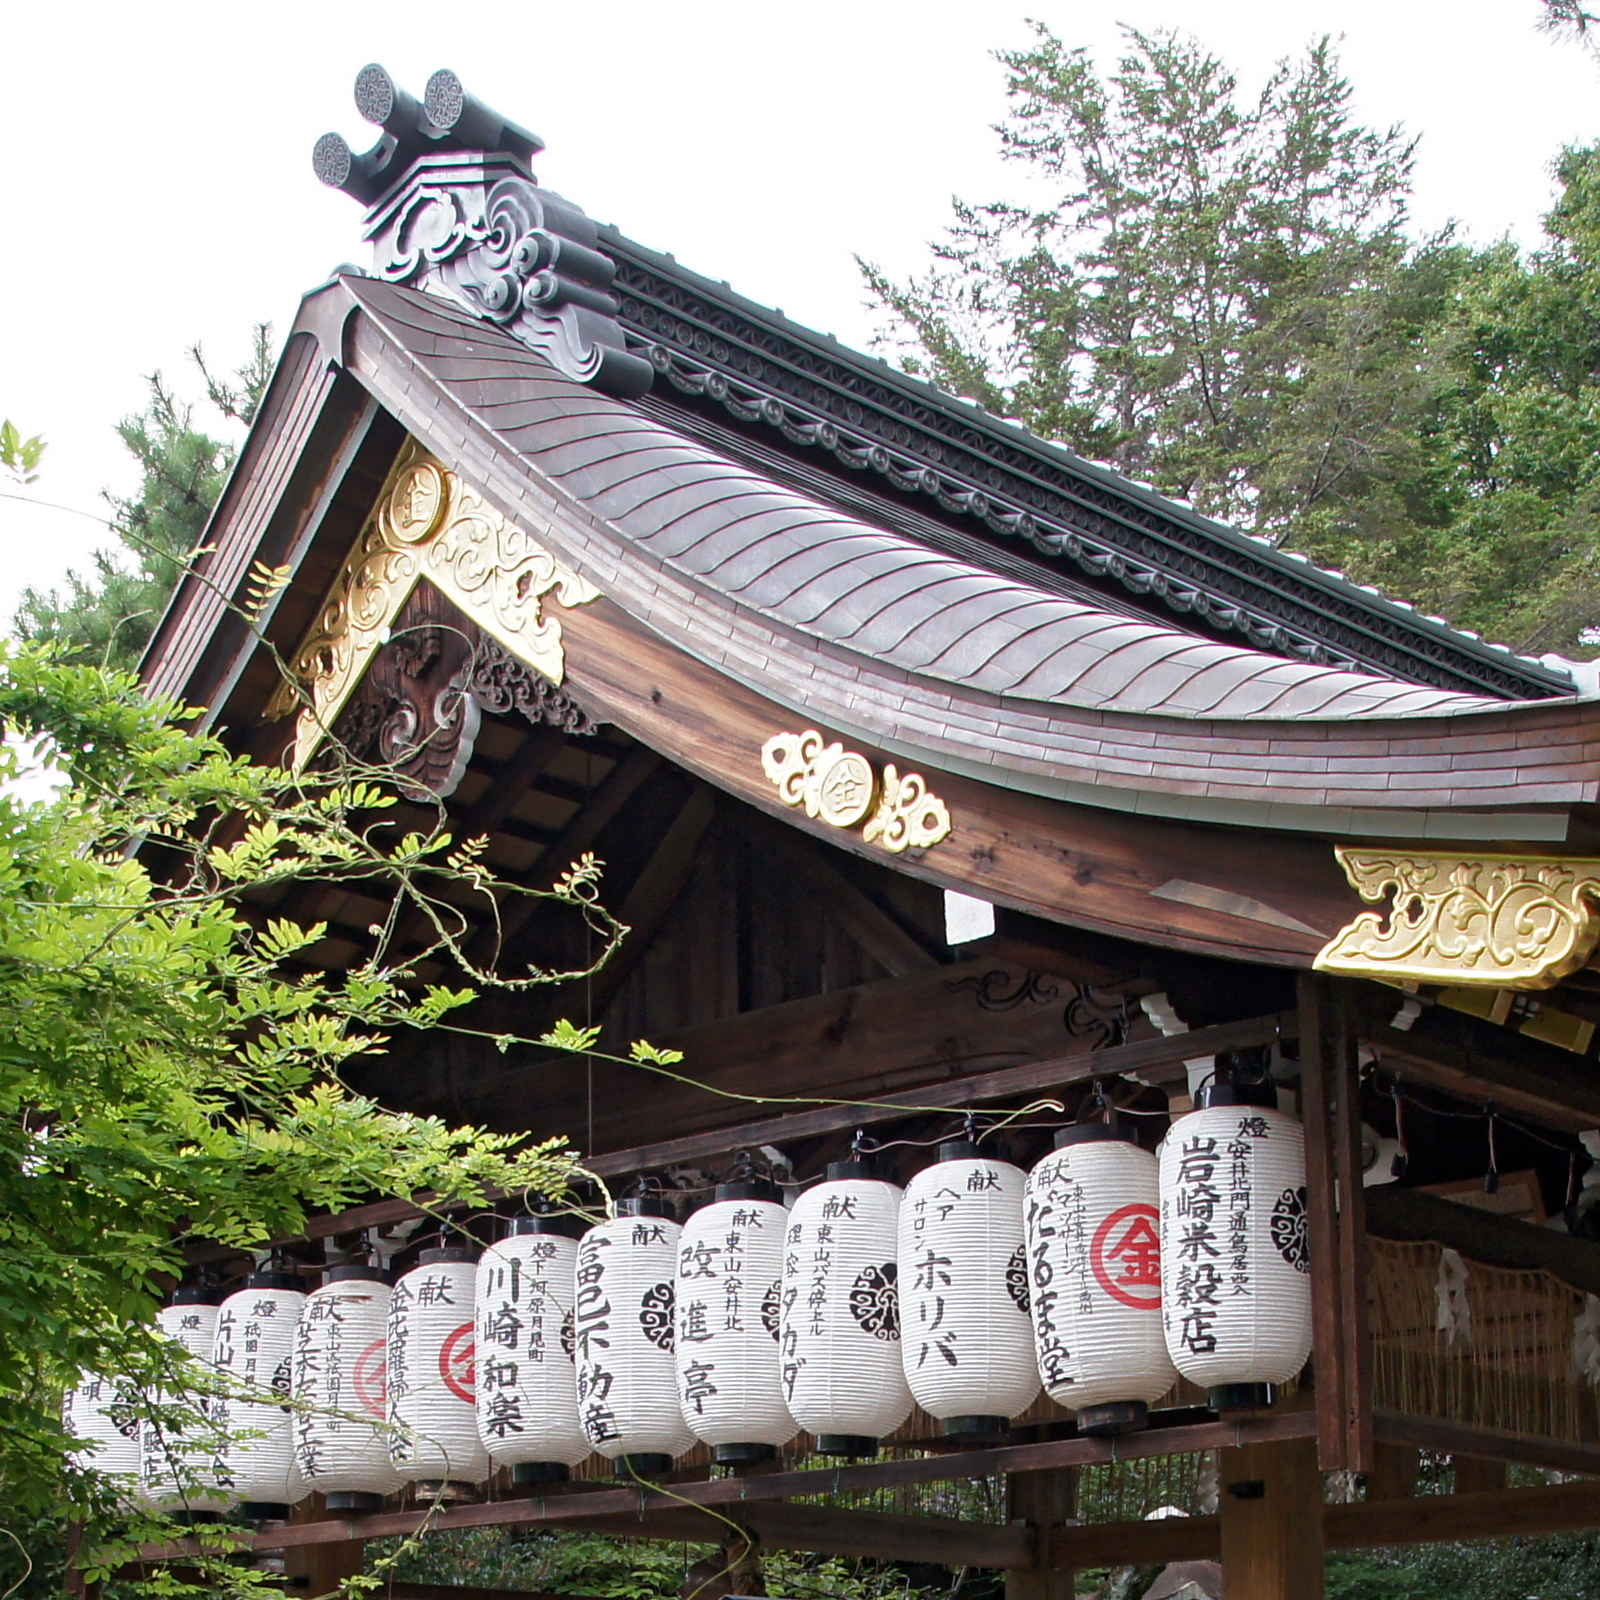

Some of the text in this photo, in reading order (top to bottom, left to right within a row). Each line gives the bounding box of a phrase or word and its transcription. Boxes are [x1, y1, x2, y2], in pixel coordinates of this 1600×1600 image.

[1237, 1116, 1271, 1139] 燈
[967, 1169, 1003, 1192] 献
[1038, 1157, 1074, 1189] 献
[732, 1207, 765, 1228] 献
[822, 1194, 859, 1220] 献
[934, 1187, 962, 1222] ヘア
[631, 1223, 669, 1247] 献
[914, 1198, 927, 1251] サロン
[530, 1241, 558, 1259] 燈
[1103, 1215, 1161, 1287] 金
[1176, 1135, 1223, 1354] 岩崎米穀店
[417, 1274, 456, 1308] 献
[722, 1229, 745, 1332] 東山安井北
[180, 1314, 204, 1331] 燈
[250, 1298, 278, 1319] 燈
[309, 1296, 345, 1323] 献
[526, 1259, 550, 1363] 下河原月見町
[912, 1249, 959, 1370] ホリバ
[324, 1322, 343, 1433] 東山区祇園月町
